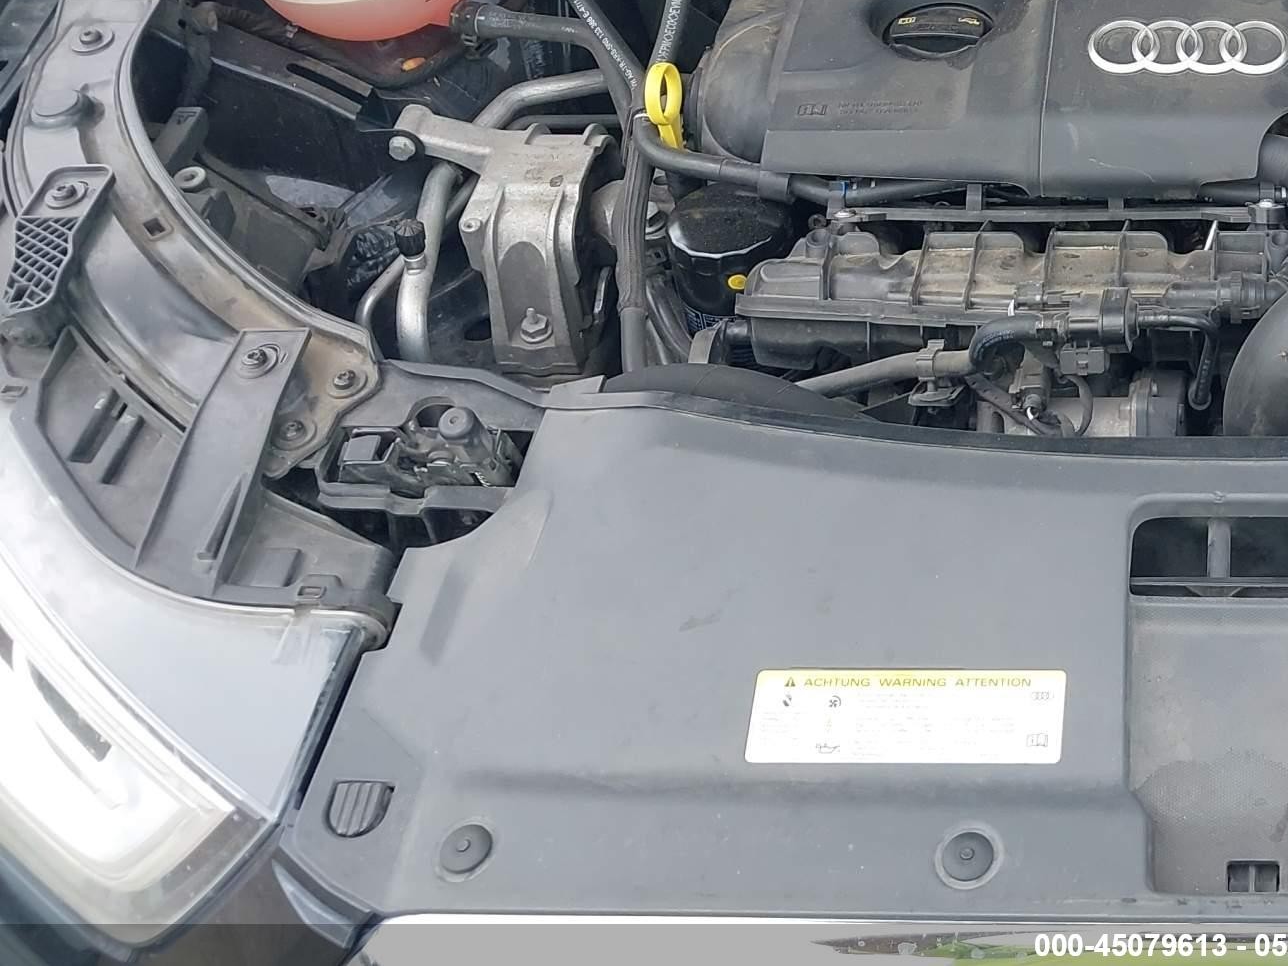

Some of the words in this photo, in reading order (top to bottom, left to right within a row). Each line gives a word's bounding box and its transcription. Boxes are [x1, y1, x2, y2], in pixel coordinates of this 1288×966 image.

[804, 677, 871, 688] ACHTUNG
[879, 677, 947, 688] WARNING
[955, 677, 1032, 688] ATTENTION
